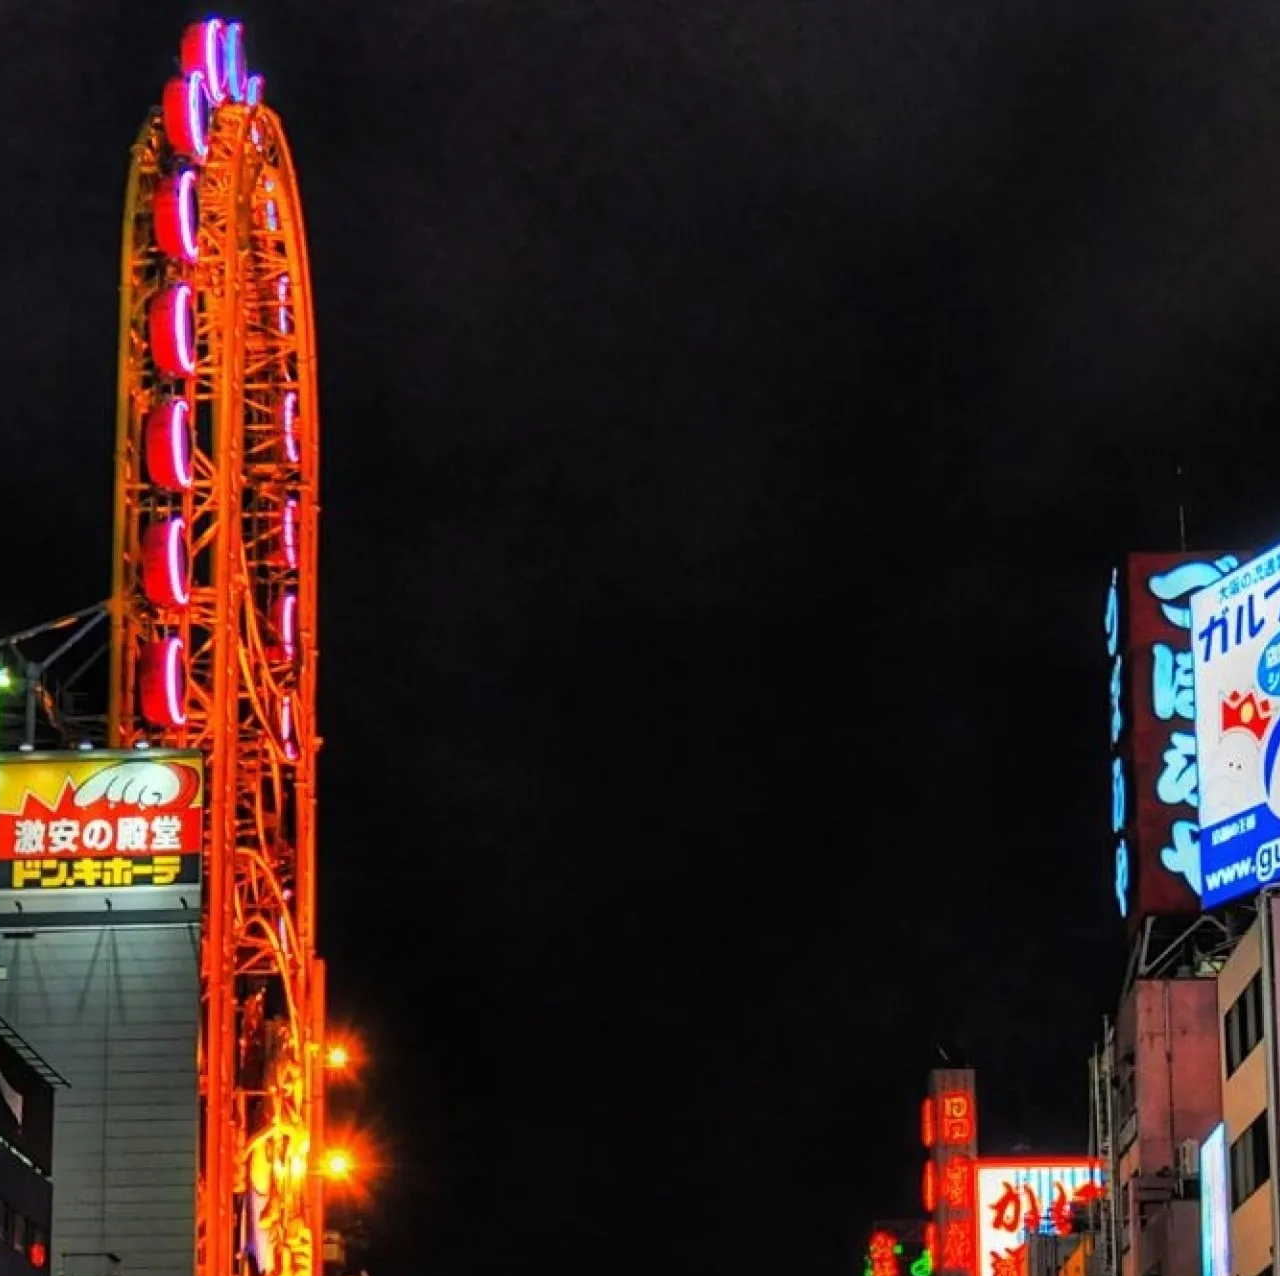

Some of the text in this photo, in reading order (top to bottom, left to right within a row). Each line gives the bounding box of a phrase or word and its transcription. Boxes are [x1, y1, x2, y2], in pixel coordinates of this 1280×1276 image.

[14, 815, 182, 854] 激安の殿堂
